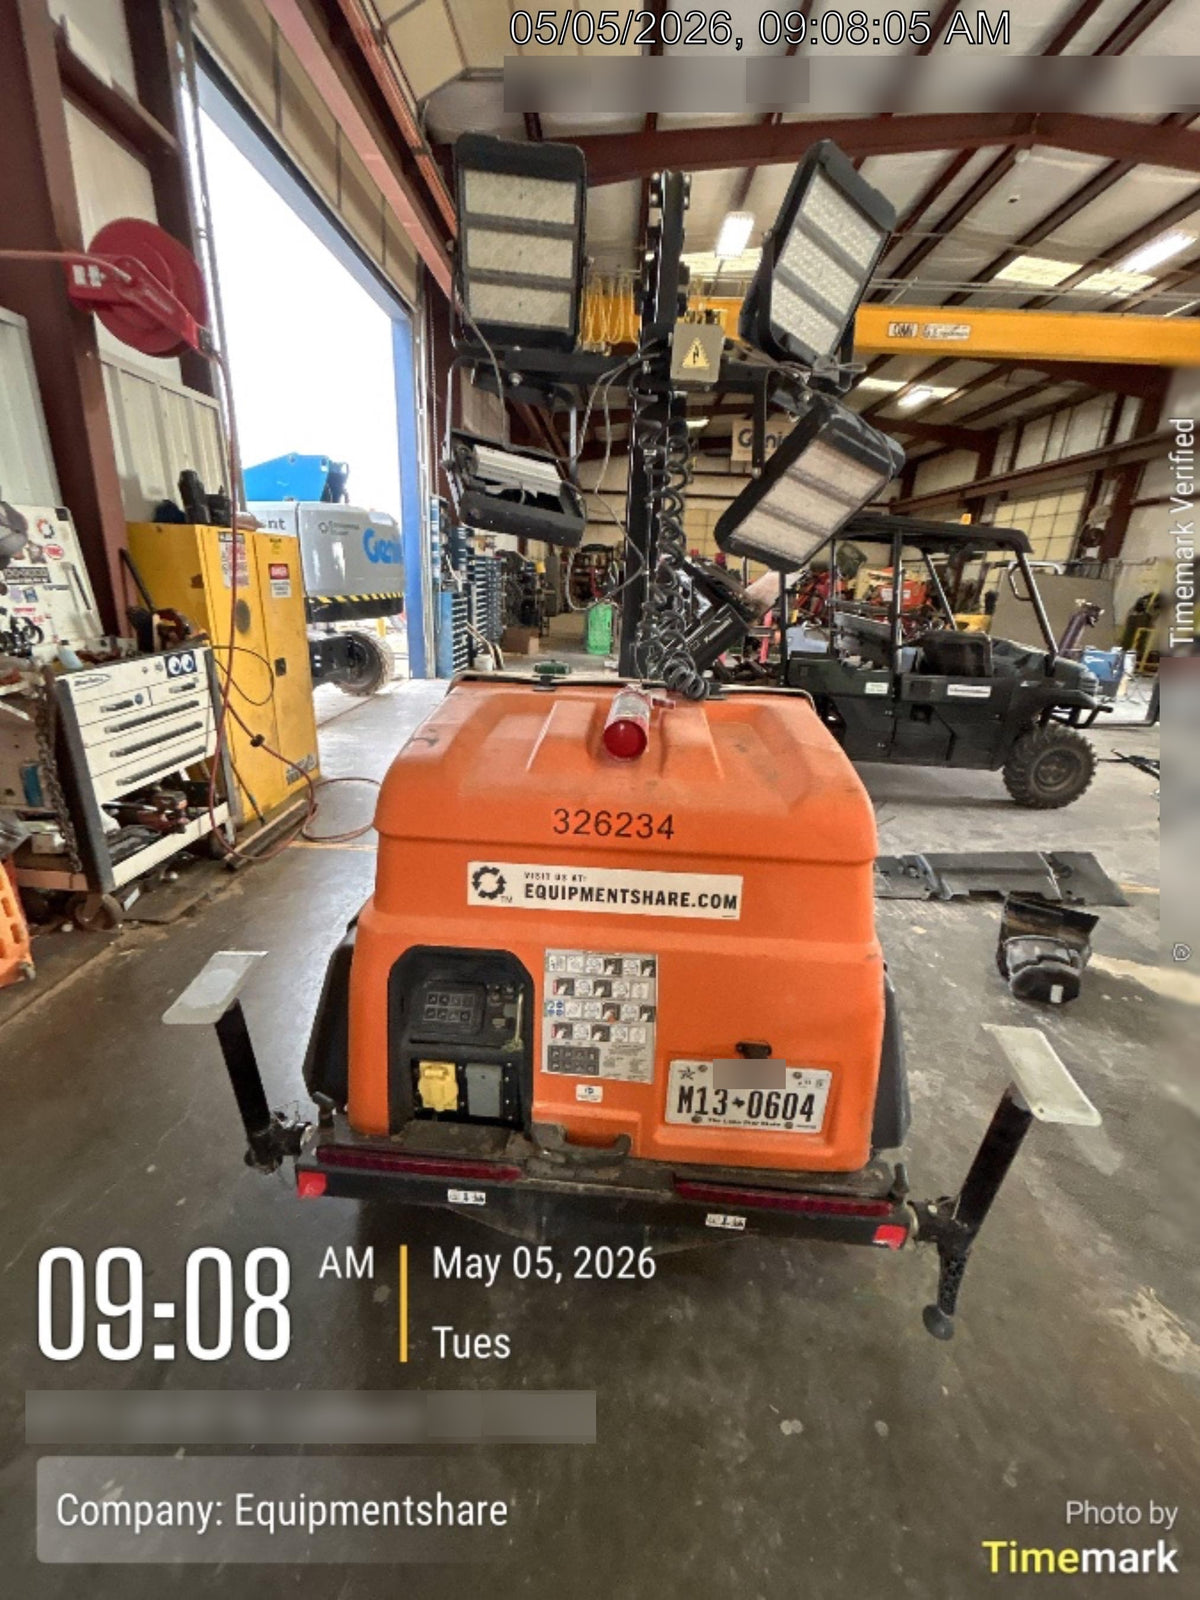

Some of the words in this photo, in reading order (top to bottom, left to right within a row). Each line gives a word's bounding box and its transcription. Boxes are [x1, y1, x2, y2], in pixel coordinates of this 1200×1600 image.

[552, 808, 676, 841] 326234
[524, 872, 550, 881] VISIT
[524, 883, 738, 910] EQUIPMENTSHARE.COM
